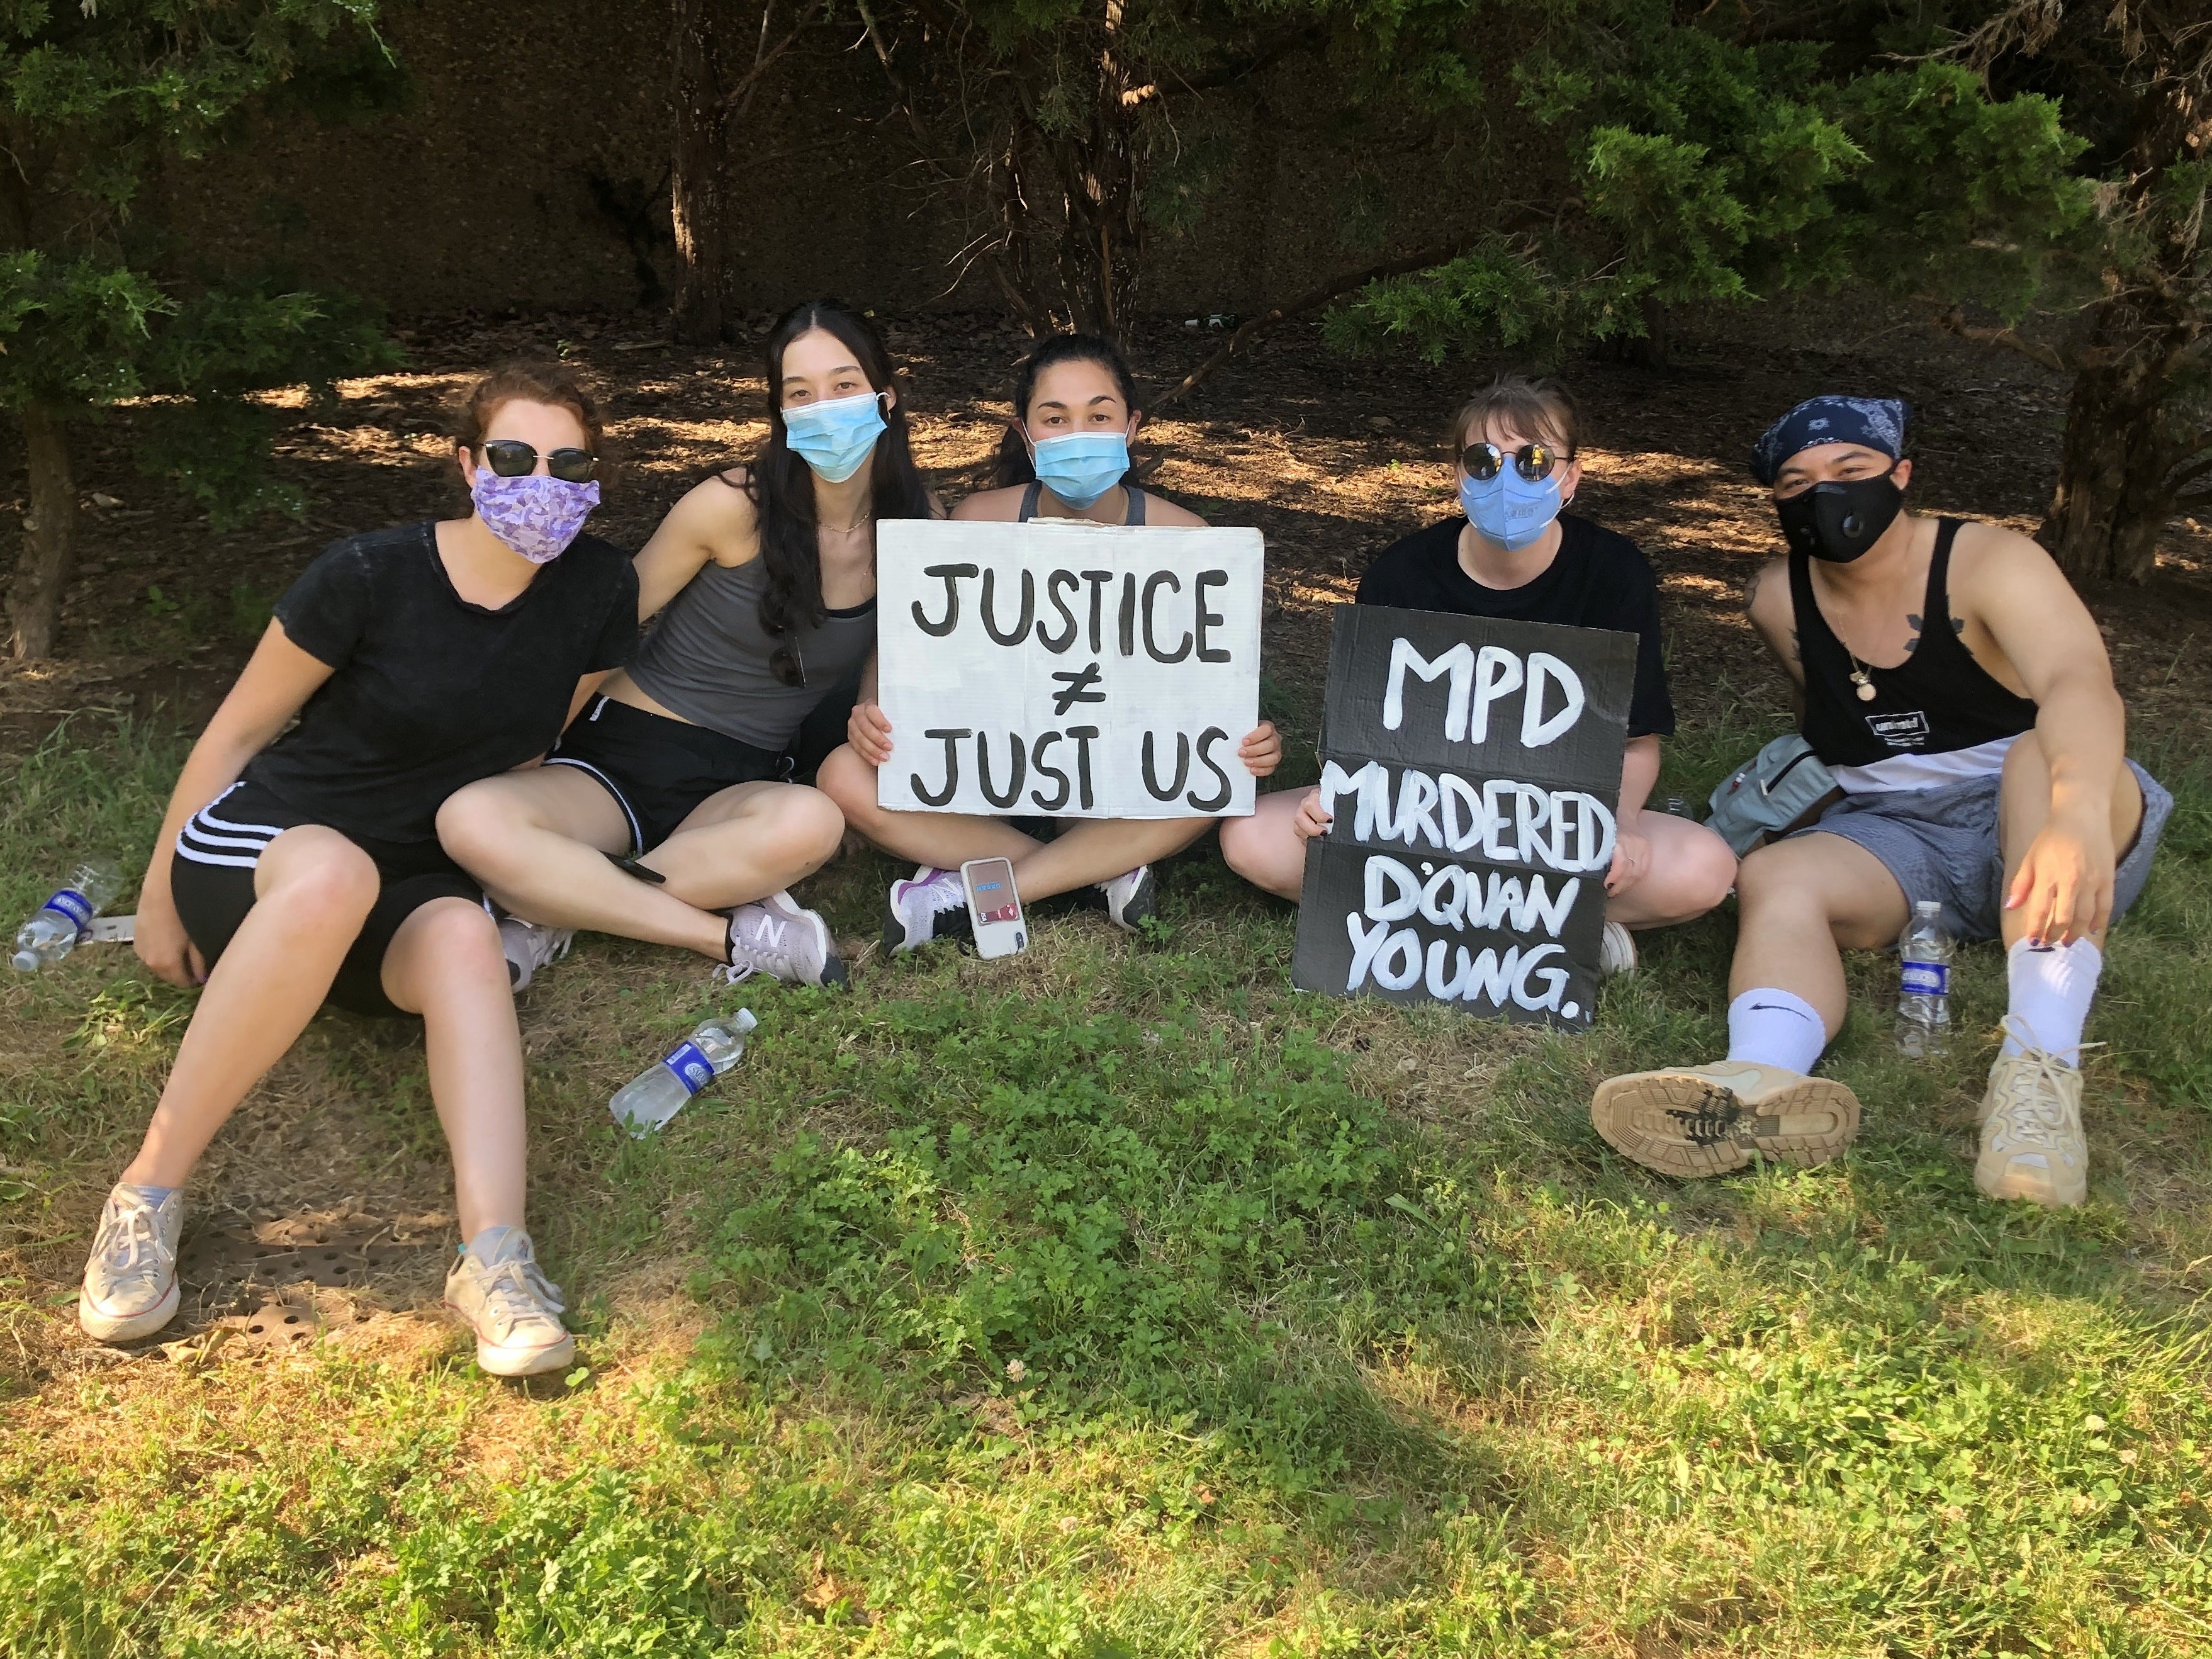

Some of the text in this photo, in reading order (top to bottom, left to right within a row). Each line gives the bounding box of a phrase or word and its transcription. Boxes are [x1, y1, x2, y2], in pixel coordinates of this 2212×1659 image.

[911, 563, 1232, 663] JUSTICE
[1383, 636, 1585, 748] MPD
[910, 725, 1233, 813] JUST US
[1319, 759, 1617, 872] MURDERED
[755, 914, 787, 948] N
[1346, 911, 1580, 1019] YOUNG.
